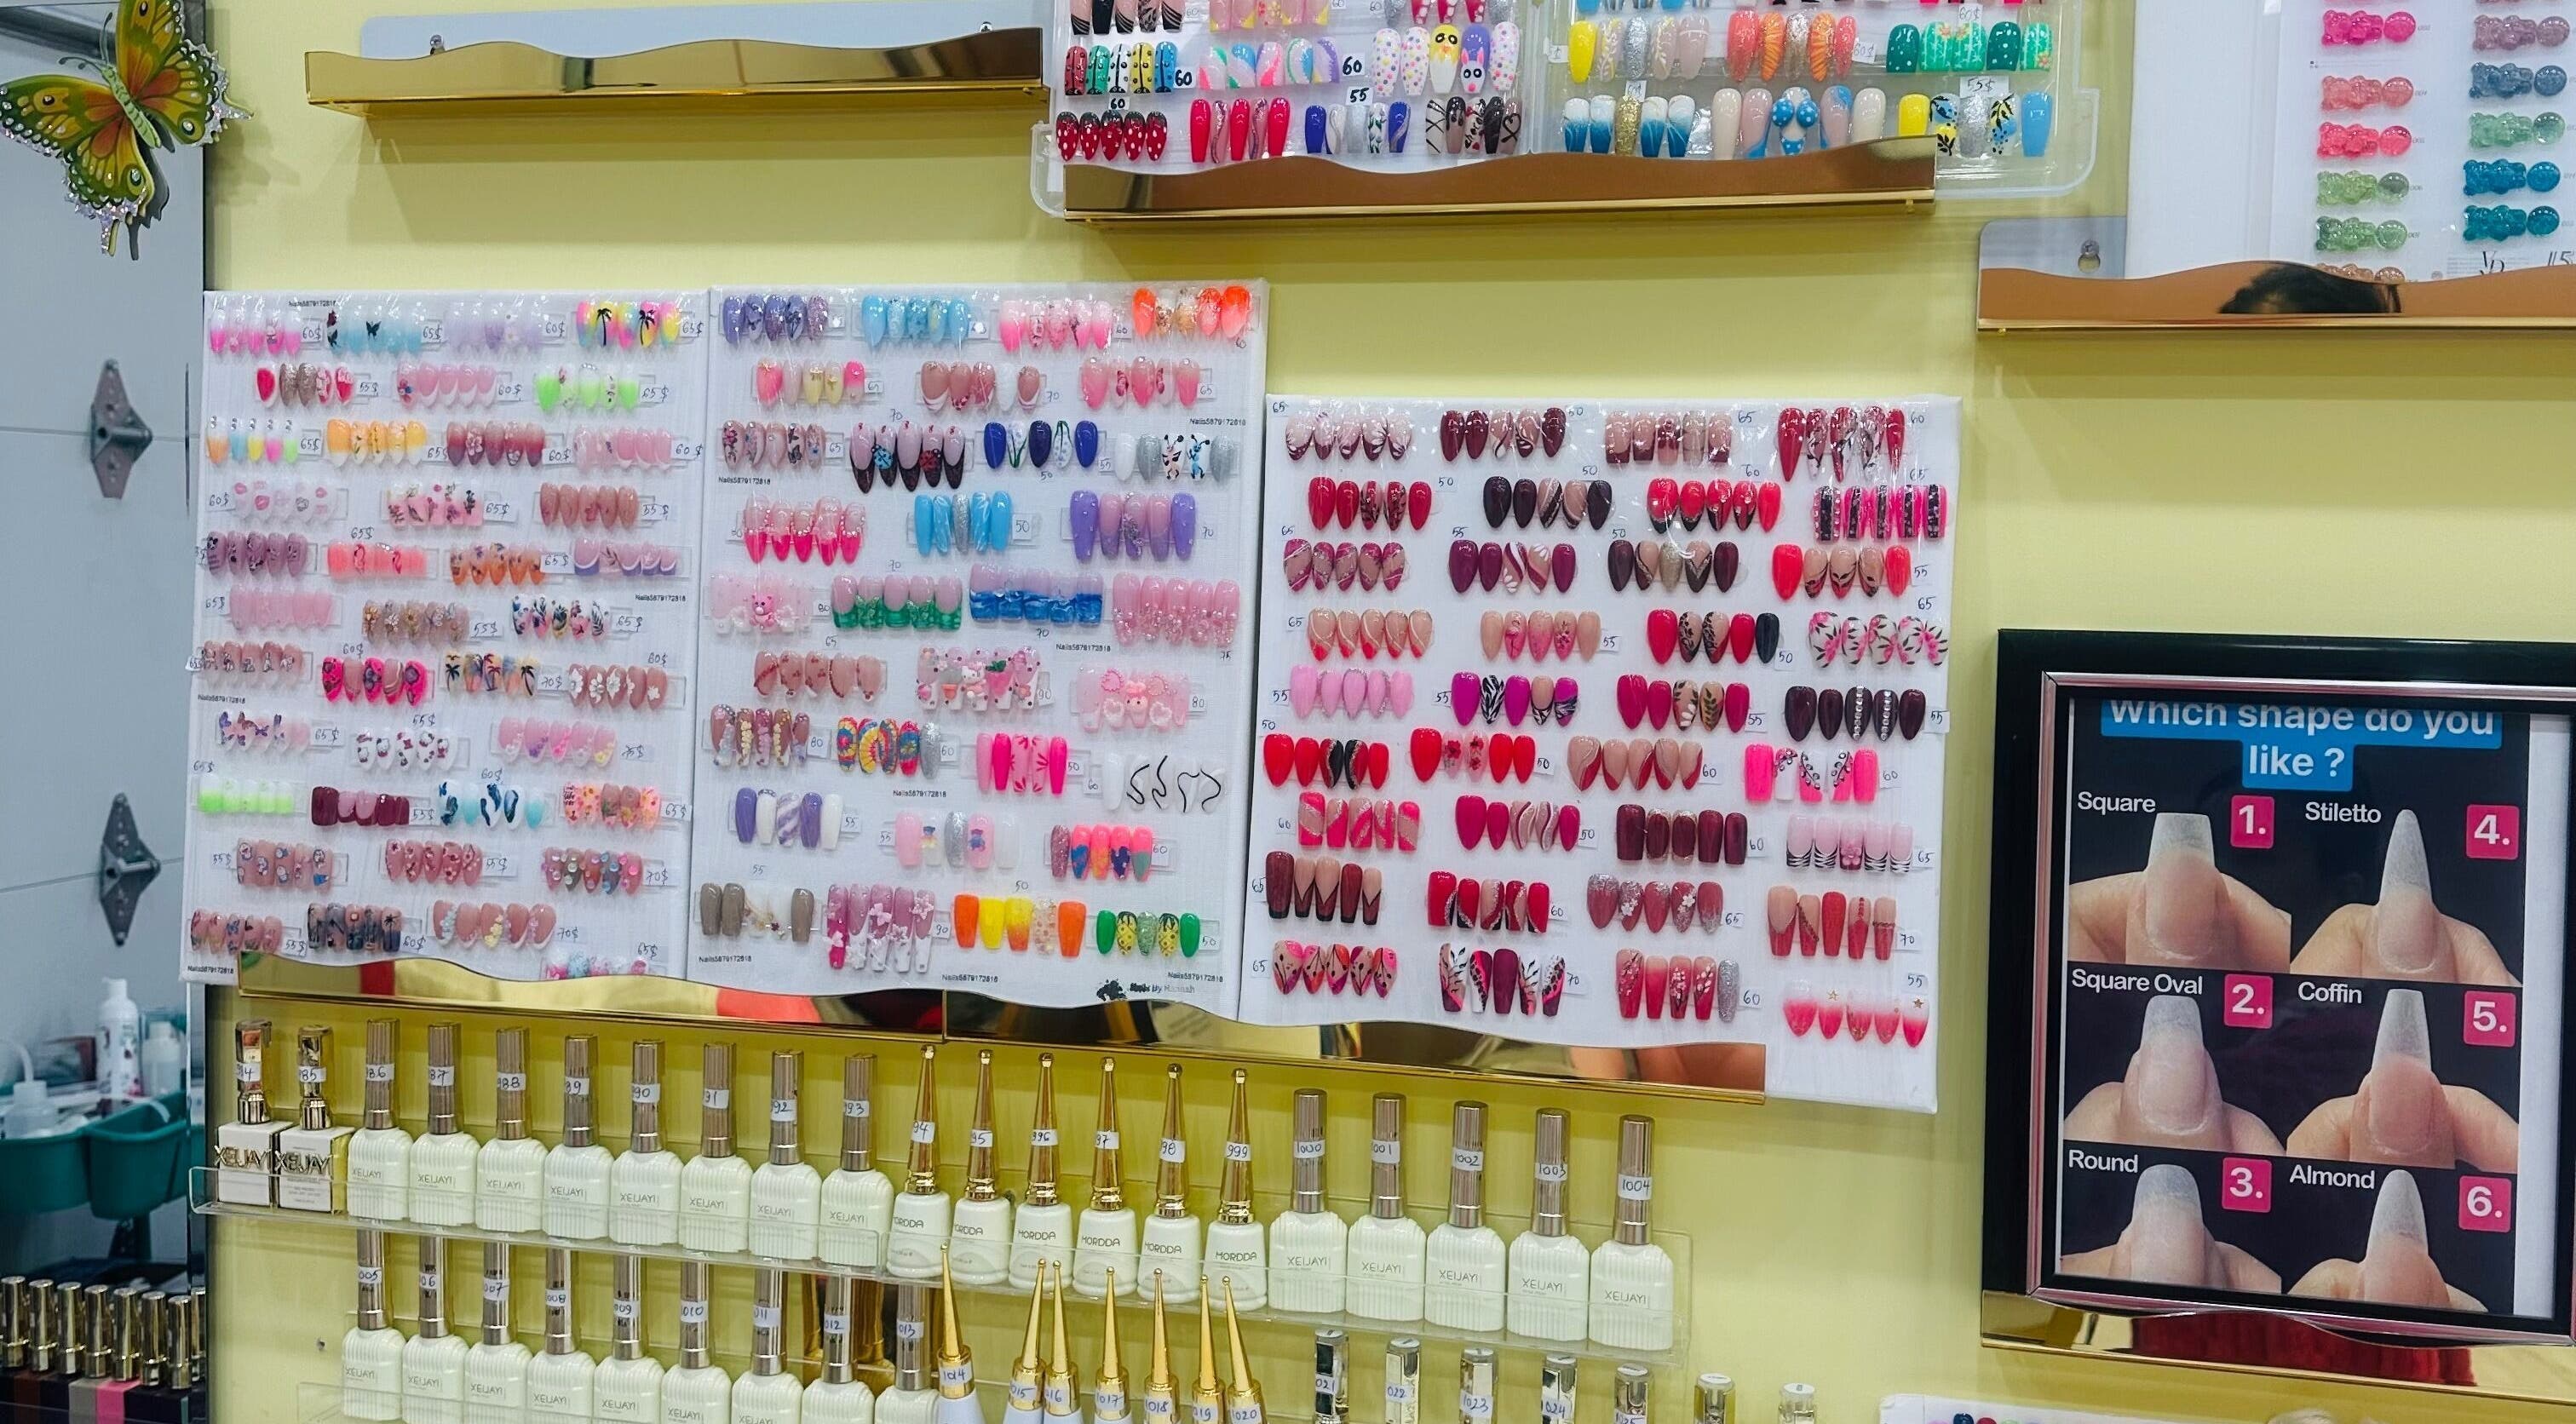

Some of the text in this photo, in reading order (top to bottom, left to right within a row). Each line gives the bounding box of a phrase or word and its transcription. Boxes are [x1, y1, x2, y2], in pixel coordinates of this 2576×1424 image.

[1370, 3, 1382, 11] 60
[1959, 7, 1980, 20] 60$
[1343, 58, 1363, 75] 60
[1176, 72, 1192, 85] 60
[1968, 78, 1995, 91] 55$
[1349, 88, 1369, 103] 55
[1111, 99, 1125, 109] 60
[302, 327, 321, 341] 60$
[423, 326, 442, 340] 65$
[546, 322, 566, 336] 60$
[683, 322, 704, 336] 65$
[498, 384, 521, 399] 60$
[1200, 385, 1213, 394] 65
[1047, 391, 1060, 401] 70
[1273, 402, 1286, 412] 65
[1738, 411, 1756, 422] 65
[1911, 412, 1924, 423] 60
[301, 439, 320, 451] 65$
[549, 447, 571, 461] 60$
[1041, 471, 1053, 480] 50
[1583, 466, 1598, 475] 50
[1746, 465, 1760, 477] 60
[1910, 468, 1927, 480] 65
[1439, 477, 1453, 486] 50
[210, 492, 229, 507] 60$
[486, 503, 510, 519] 65$
[1016, 520, 1029, 532] 50
[1201, 527, 1214, 537] 70
[1282, 525, 1295, 535] 65
[1452, 527, 1468, 537] 55
[351, 526, 375, 540] 65$
[1613, 529, 1626, 537] 50
[545, 555, 569, 566] 65$
[889, 560, 901, 570] 70
[1915, 565, 1929, 576] 55
[205, 596, 225, 610] 65$
[1918, 596, 1936, 610] 65
[1289, 617, 1306, 627] 65
[1036, 629, 1049, 638] 70
[1603, 636, 1619, 647] 55
[342, 643, 364, 658] 60$
[1780, 651, 1793, 663] 50
[1039, 689, 1052, 700] 90
[1273, 690, 1290, 702] 55
[1436, 692, 1452, 703] 55
[1193, 698, 1205, 708] 80
[1748, 714, 1764, 726] 55
[1931, 710, 1948, 724] 55
[2109, 699, 2495, 740] Which shape do you
[1262, 720, 1276, 730] 50
[315, 728, 338, 741] 65$
[811, 738, 824, 748] 80
[941, 746, 954, 755] 60
[1538, 758, 1550, 769] 50
[2249, 745, 2345, 778] like ?
[1703, 765, 1716, 778] 60
[1883, 771, 1898, 780] 60
[1089, 781, 1098, 790] 60
[2077, 791, 2156, 815] Square
[665, 804, 687, 818] 65$
[2305, 802, 2382, 824] Stiletto
[845, 818, 858, 827] 55
[1278, 818, 1291, 829] 60
[2238, 804, 2267, 835] 1.
[1579, 830, 1595, 840] 50
[2474, 814, 2511, 846] 4.
[881, 832, 891, 841] 55
[1153, 846, 1167, 854] 60
[1750, 838, 1764, 850] 60
[1918, 852, 1935, 863] 65
[753, 865, 763, 874] 55
[1015, 881, 1028, 892] 50
[1252, 876, 1266, 893] 65
[1550, 906, 1564, 916] 60
[1725, 913, 1743, 925] 65
[1203, 937, 1216, 946] 50
[1900, 933, 1914, 945] 70
[286, 939, 306, 953] 55$
[1253, 960, 1268, 972] 65
[1567, 973, 1579, 985] 70
[1908, 974, 1925, 988] 55
[2071, 968, 2204, 996] Square Oval
[1743, 990, 1761, 1005] 60
[2298, 981, 2362, 1004] Coffin
[2231, 984, 2265, 1015] 2.
[2472, 1001, 2508, 1033] 5.
[1227, 1145, 1248, 1158] 999
[1455, 1154, 1480, 1167] 1002
[2069, 1150, 2138, 1174] Round
[1538, 1163, 1567, 1176] 1003
[2229, 1166, 2263, 1199] 3.
[2289, 1165, 2376, 1189] Almond
[1622, 1179, 1650, 1196] 1004
[2466, 1186, 2503, 1219] 6.
[359, 1270, 381, 1281] 005
[484, 1283, 509, 1296] 007
[1522, 1278, 1562, 1292] XEIJAYI
[1605, 1290, 1647, 1304] XEIJAYI
[944, 1368, 966, 1381] 1014
[1316, 1378, 1335, 1392] 021
[1388, 1387, 1407, 1398] 022
[1096, 1394, 1124, 1404] 1017
[1463, 1396, 1488, 1412] 1023
[1145, 1398, 1168, 1413] 1018
[1545, 1400, 1566, 1419] 024
